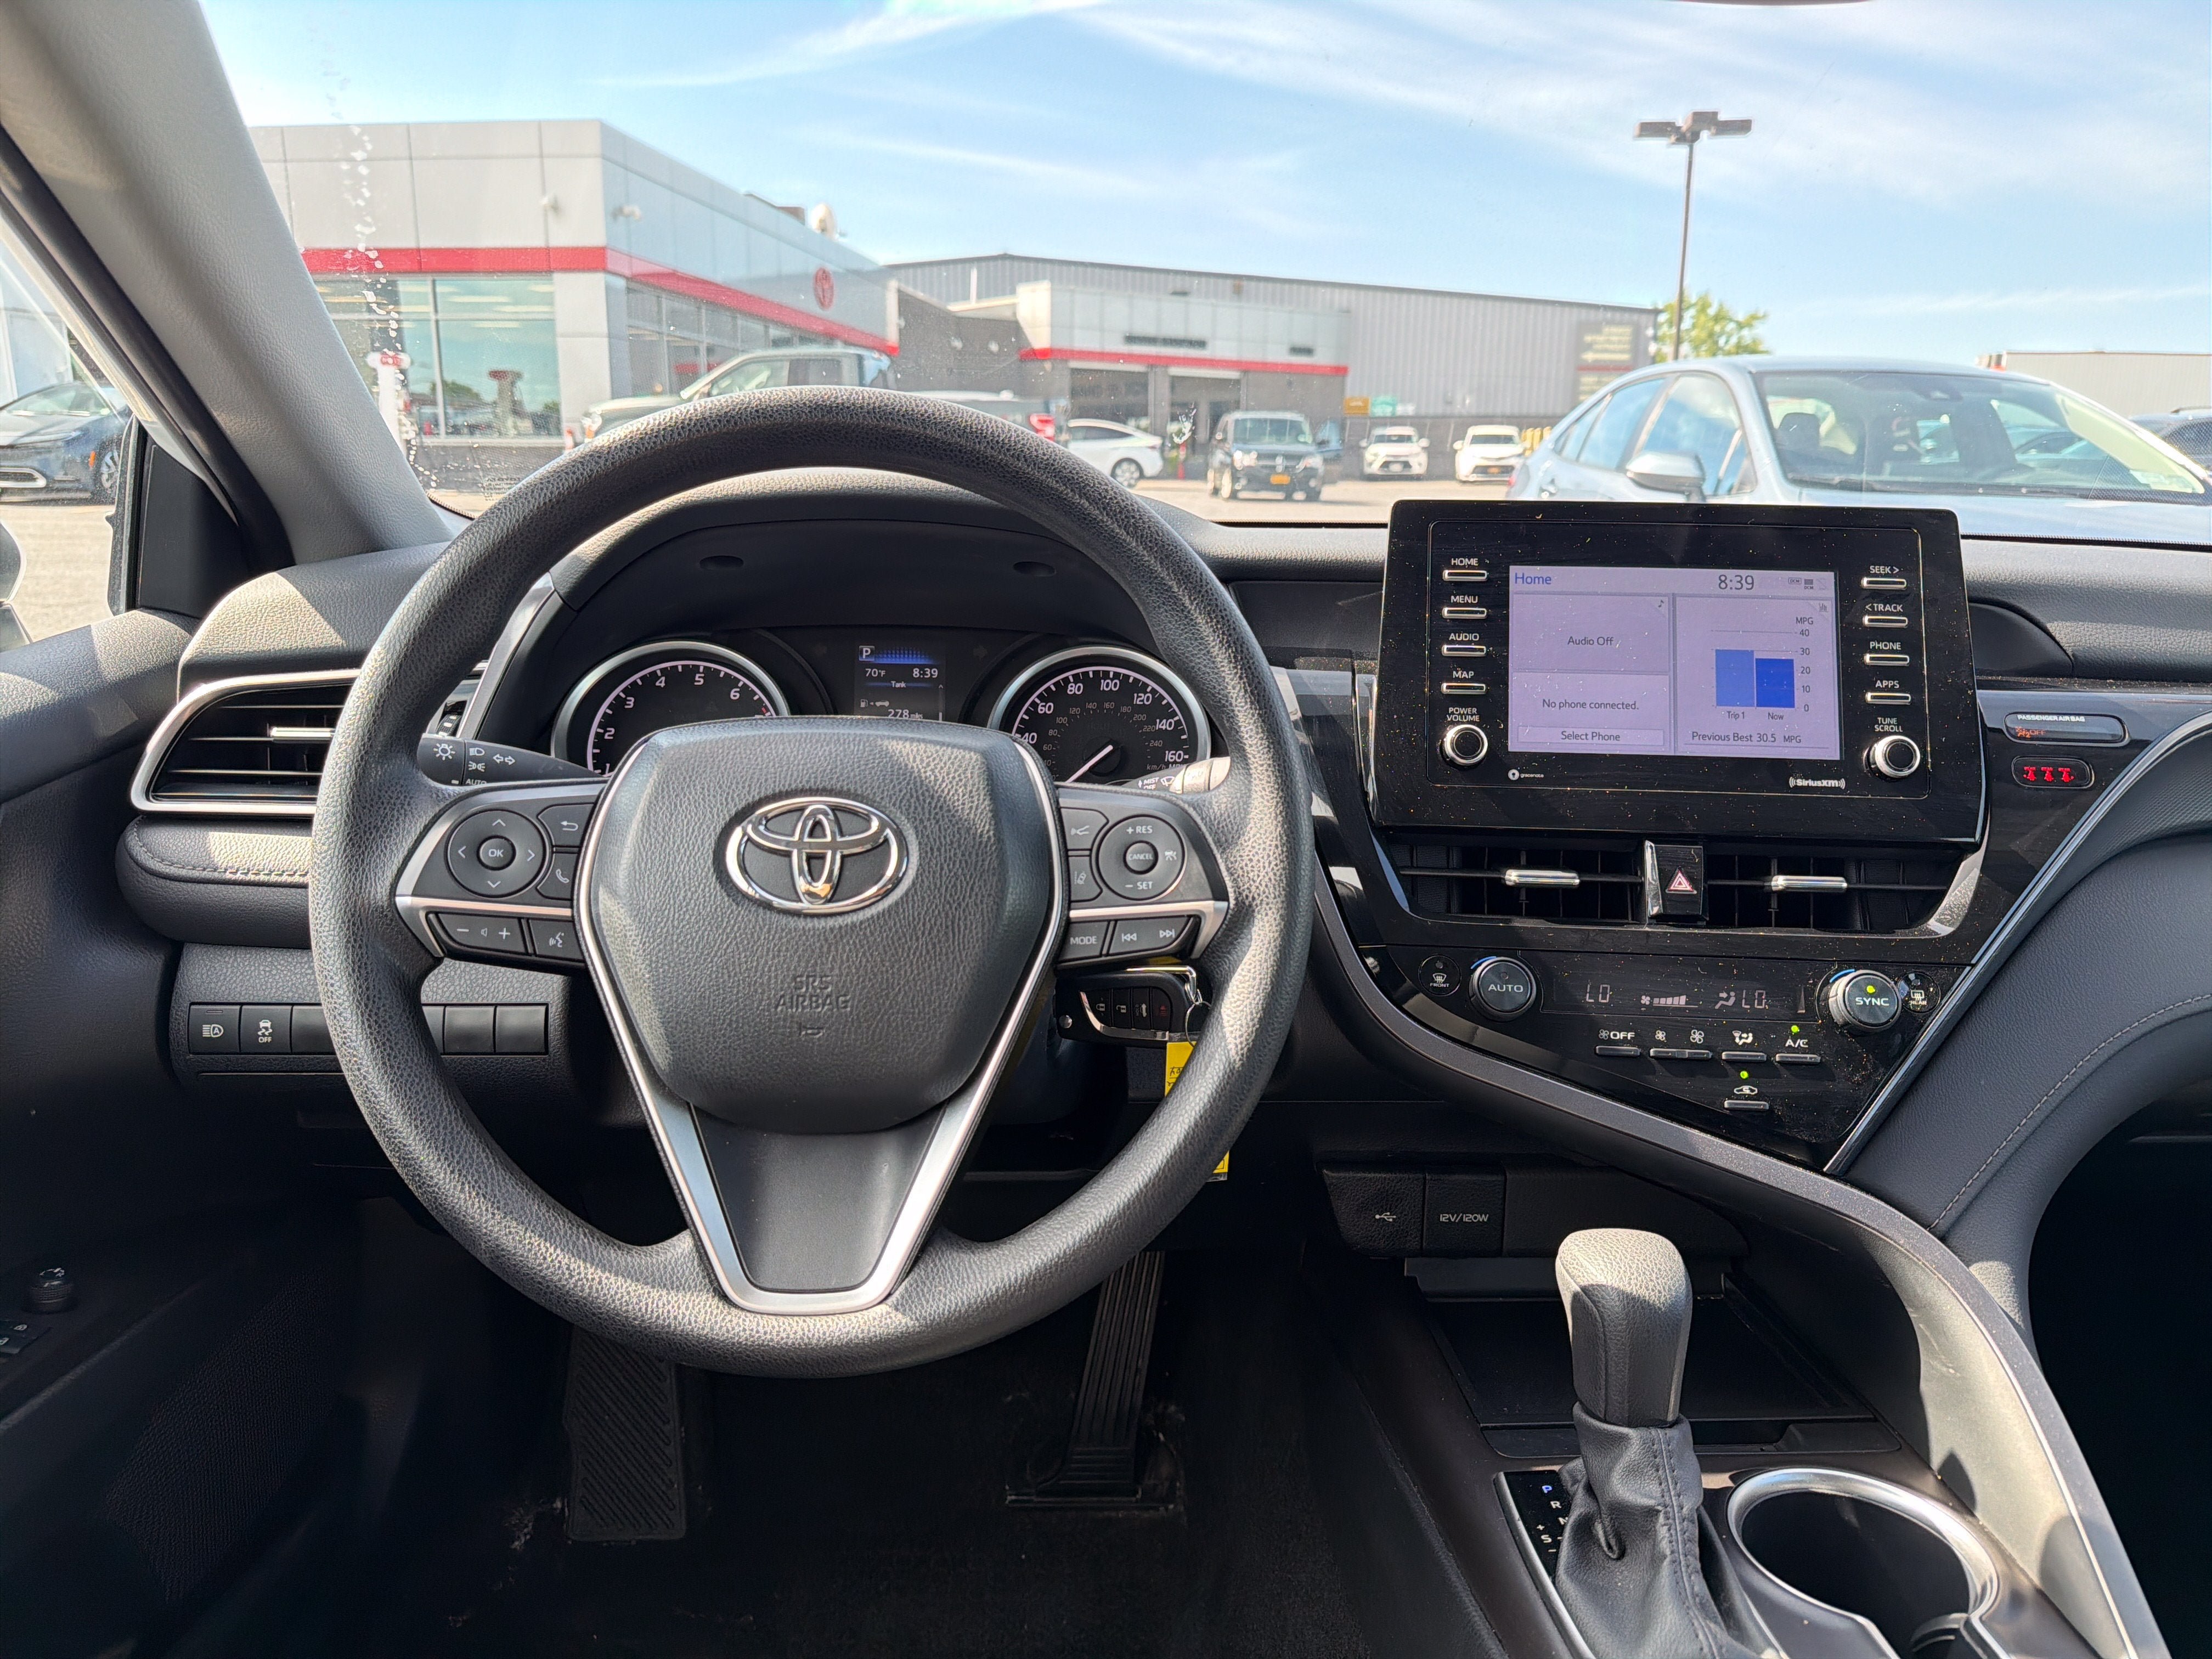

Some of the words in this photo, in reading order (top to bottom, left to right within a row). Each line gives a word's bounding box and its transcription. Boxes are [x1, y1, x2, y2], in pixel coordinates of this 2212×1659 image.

[1514, 572, 1551, 585] Home
[1718, 574, 1754, 590] 8:39
[1796, 617, 1814, 625] MPG
[1799, 629, 1809, 637] 40
[1567, 636, 1594, 645] Audio
[1596, 636, 1613, 646] Off
[1870, 641, 1901, 650] PHONE
[862, 648, 871, 659] P
[865, 668, 885, 677] 70°F
[913, 668, 938, 678] 8:39
[656, 676, 665, 687] 4
[695, 674, 704, 685] 5
[1875, 680, 1899, 689] APPS
[1067, 683, 1083, 695] 80
[1100, 679, 1120, 691] 100
[730, 689, 740, 700] 6
[1133, 693, 1152, 705] 120
[624, 697, 635, 709] 3
[1542, 699, 1556, 708] No
[1559, 699, 1587, 710] phone
[1589, 701, 1639, 710] connected.
[1038, 703, 1053, 714] 60
[888, 709, 909, 719] 278
[1726, 711, 1740, 720] Trip
[1156, 719, 1175, 730] 140
[605, 727, 615, 740] 2
[1022, 732, 1037, 744] 40
[1561, 731, 1588, 741] Select
[1591, 731, 1620, 741] Phone
[1692, 731, 1730, 741] Previous
[1733, 732, 1753, 742] Best
[1756, 733, 1776, 743] 30.5
[1783, 735, 1801, 743] MPG
[1165, 751, 1183, 762] 160
[488, 849, 504, 857] OK
[1137, 881, 1153, 890] SET
[1070, 936, 1097, 945] MODE
[1488, 984, 1523, 992] AUTO
[1855, 997, 1889, 1006] SYNC
[1610, 1031, 1635, 1040] OFF
[1785, 1039, 1808, 1048] A/C
[1440, 1214, 1488, 1222] 12V/120W
[1542, 1485, 1552, 1493] P
[1541, 1534, 1552, 1543] S
